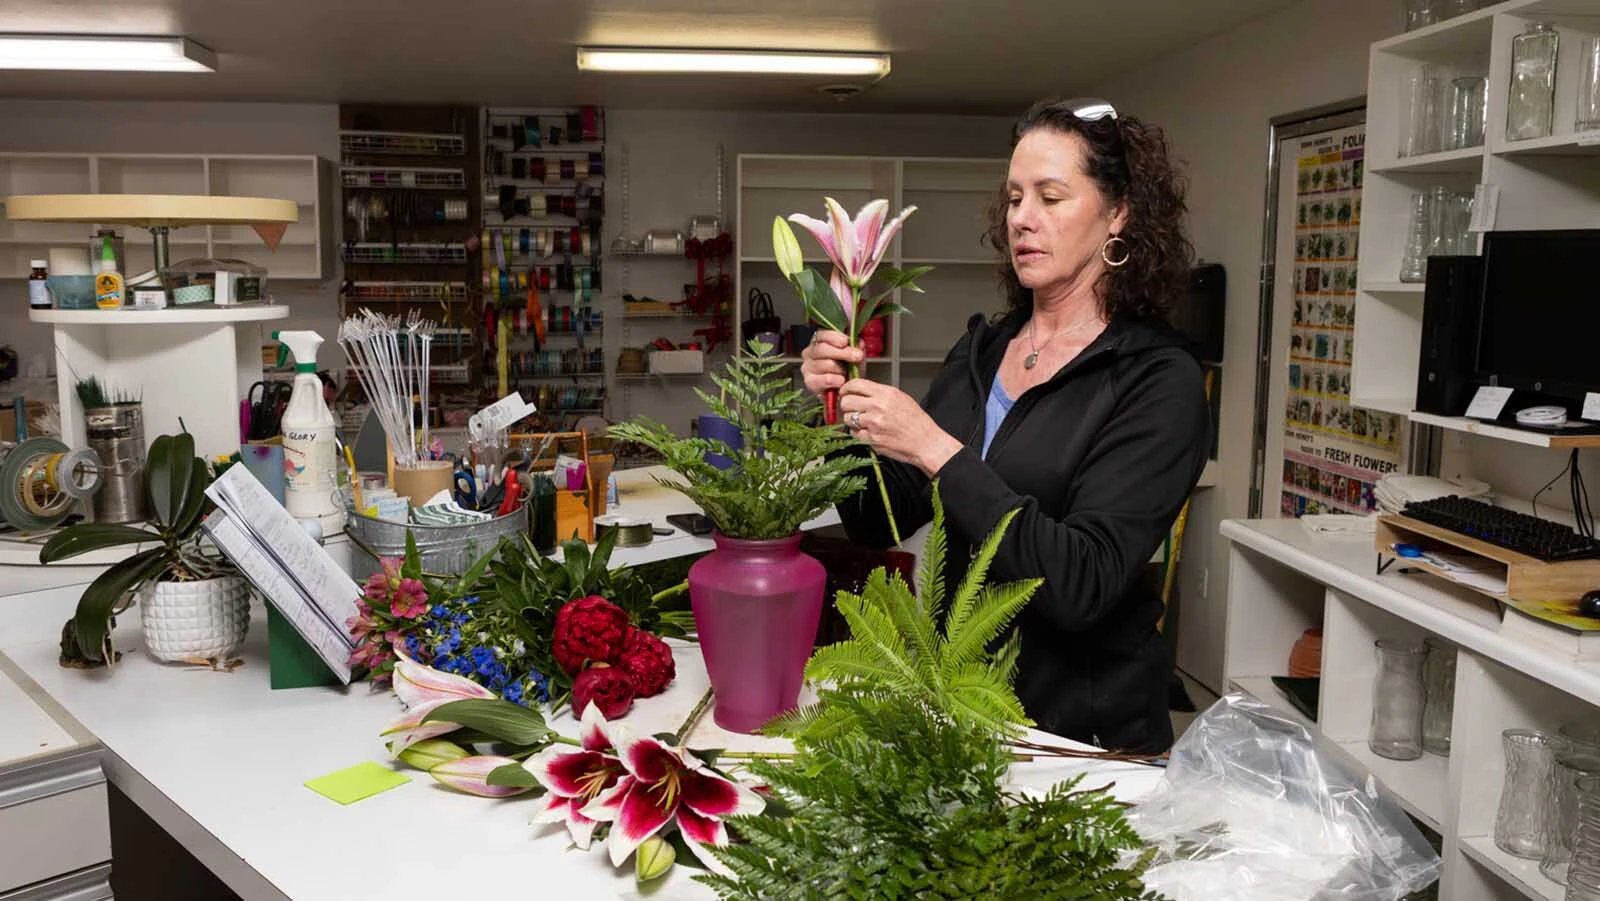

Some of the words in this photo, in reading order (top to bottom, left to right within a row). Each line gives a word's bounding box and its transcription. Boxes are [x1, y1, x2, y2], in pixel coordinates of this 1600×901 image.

[288, 431, 317, 442] GLORY
[1324, 447, 1352, 464] FRESH
[1353, 454, 1399, 474] FLOWERS
